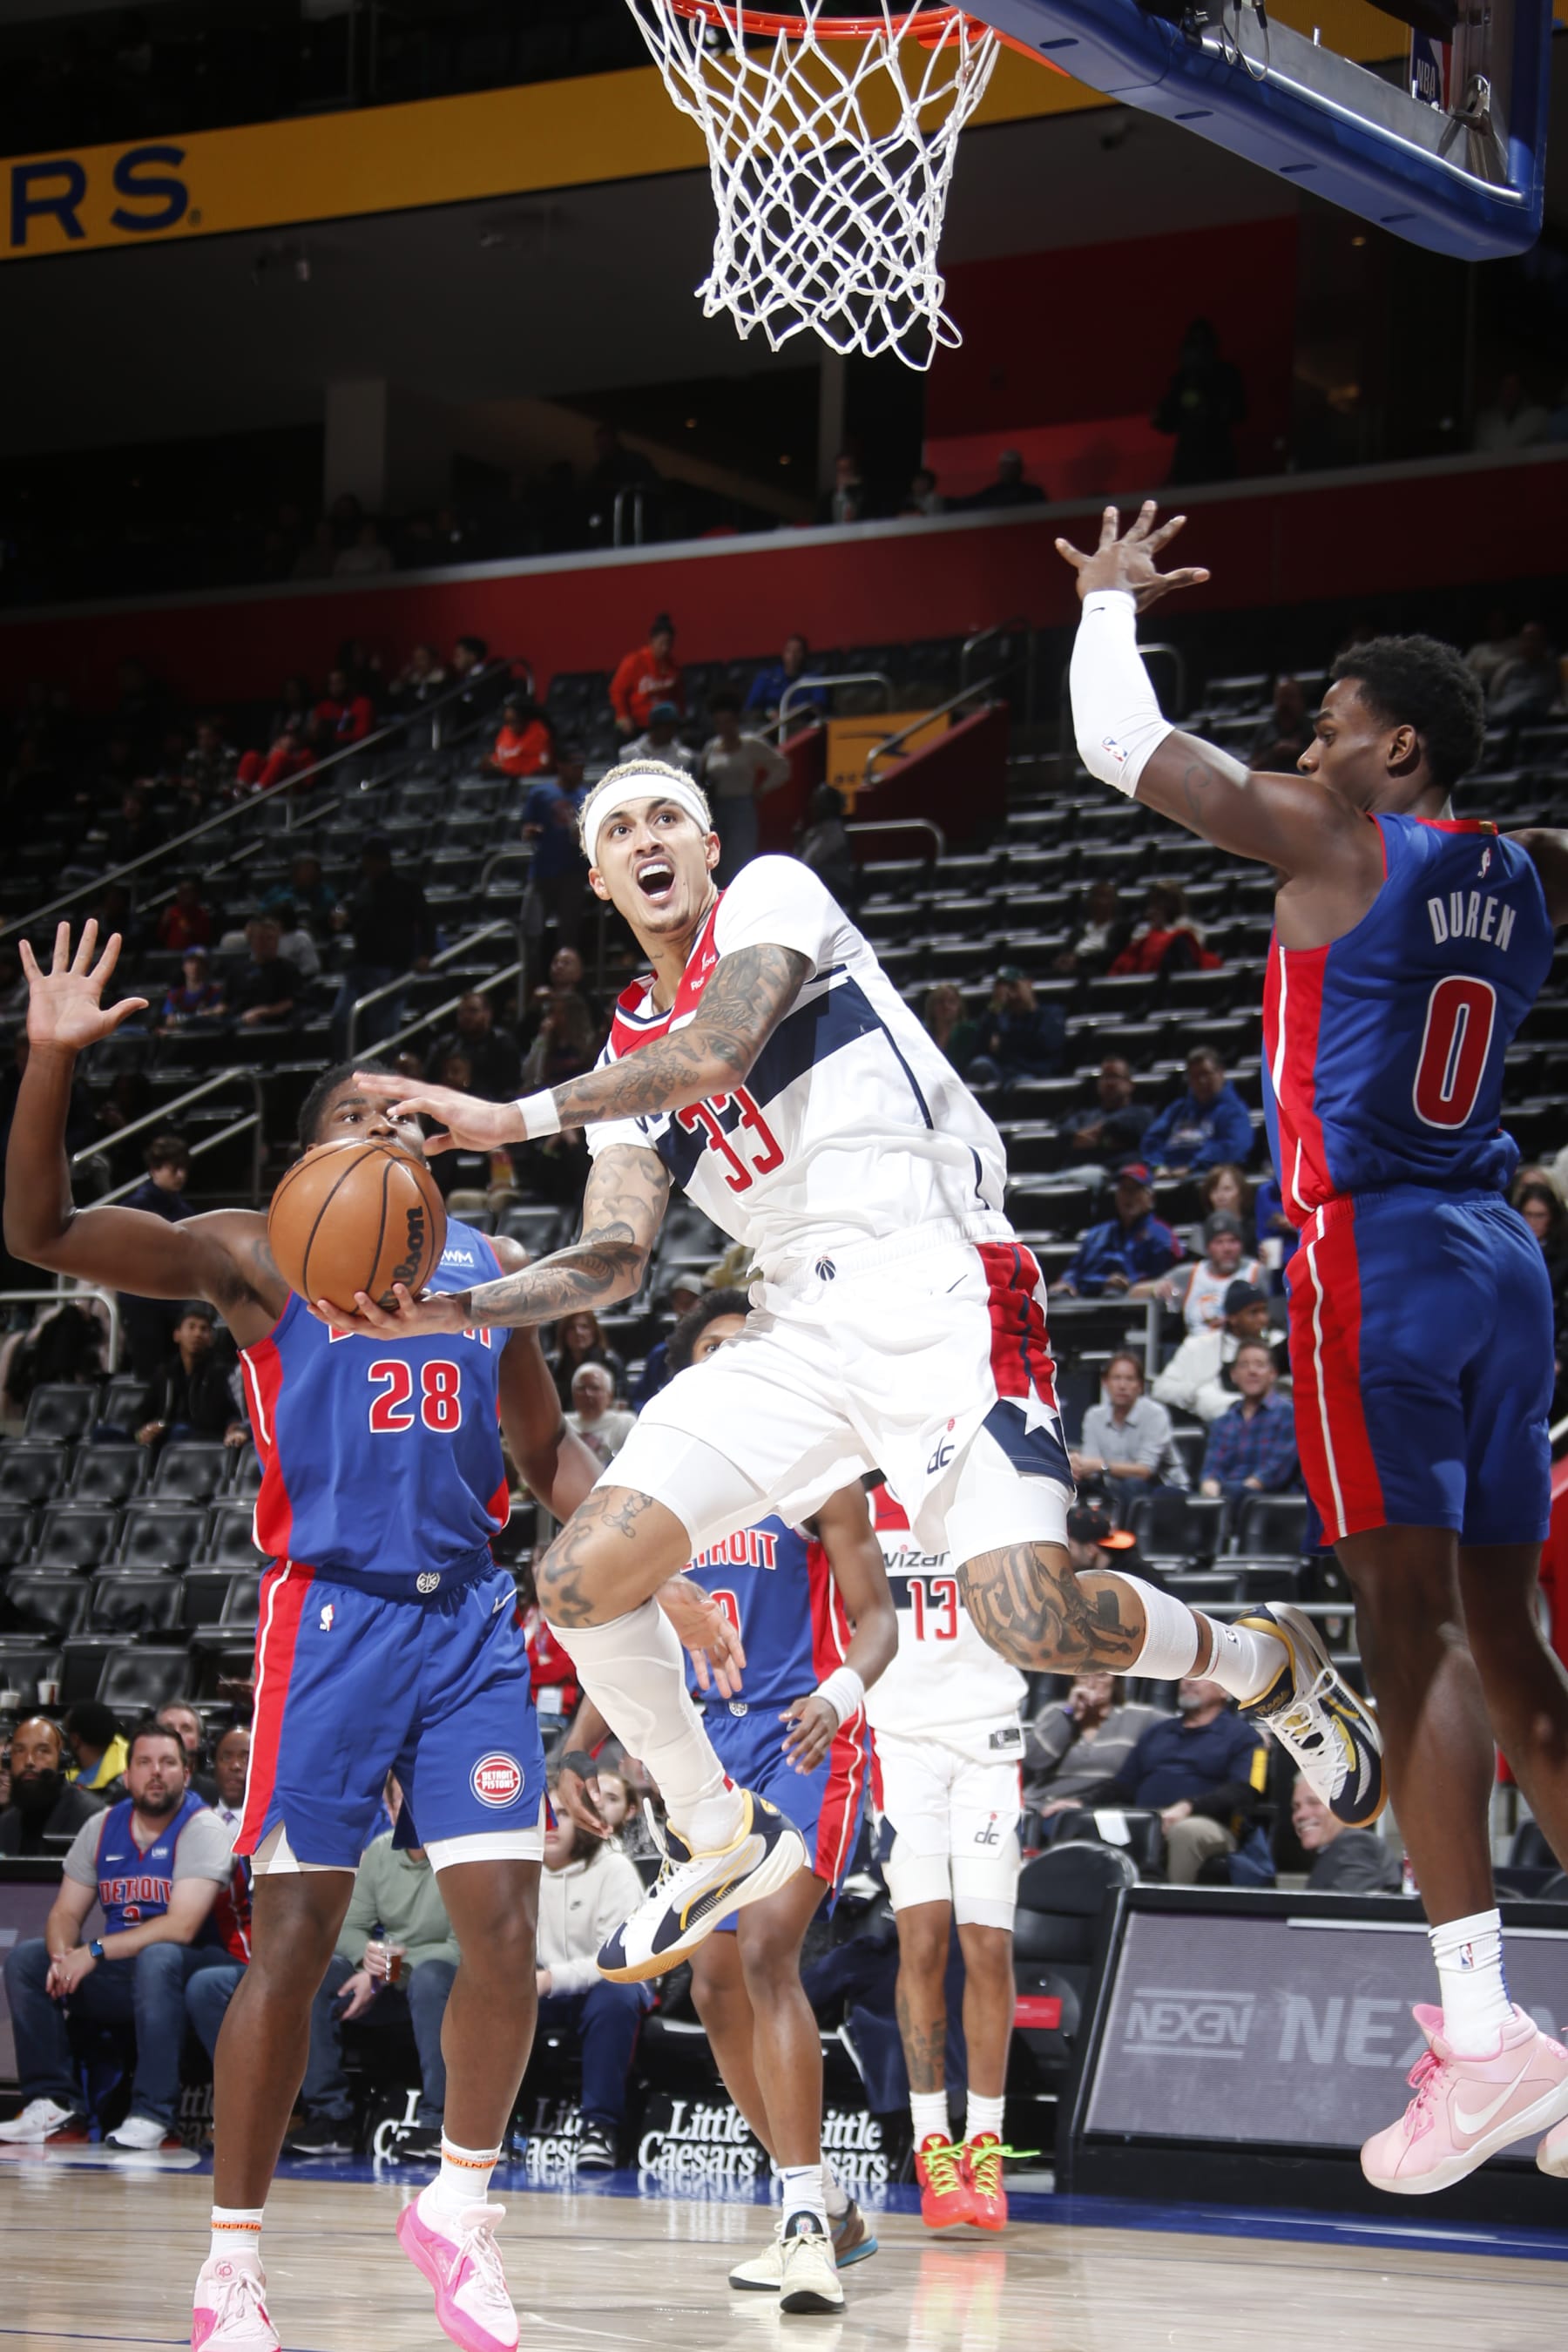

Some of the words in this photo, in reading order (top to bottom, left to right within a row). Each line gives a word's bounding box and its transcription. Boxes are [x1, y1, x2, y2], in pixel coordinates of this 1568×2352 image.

[1416, 58, 1436, 100] NBA
[1427, 890, 1517, 952] DUREN
[1412, 975, 1497, 1130] 0
[675, 1085, 785, 1194] 33
[368, 1359, 462, 1434] 28
[882, 1544, 951, 1568] wizar
[907, 1578, 958, 1643] 13
[481, 1770, 514, 1781] DETROIT
[481, 1780, 515, 1790] PISTONS
[98, 1876, 172, 1906] DETROIT
[665, 2099, 750, 2144] Little
[820, 2109, 882, 2151] ittle
[638, 2131, 758, 2176] Caesars
[828, 2150, 889, 2184] sars
